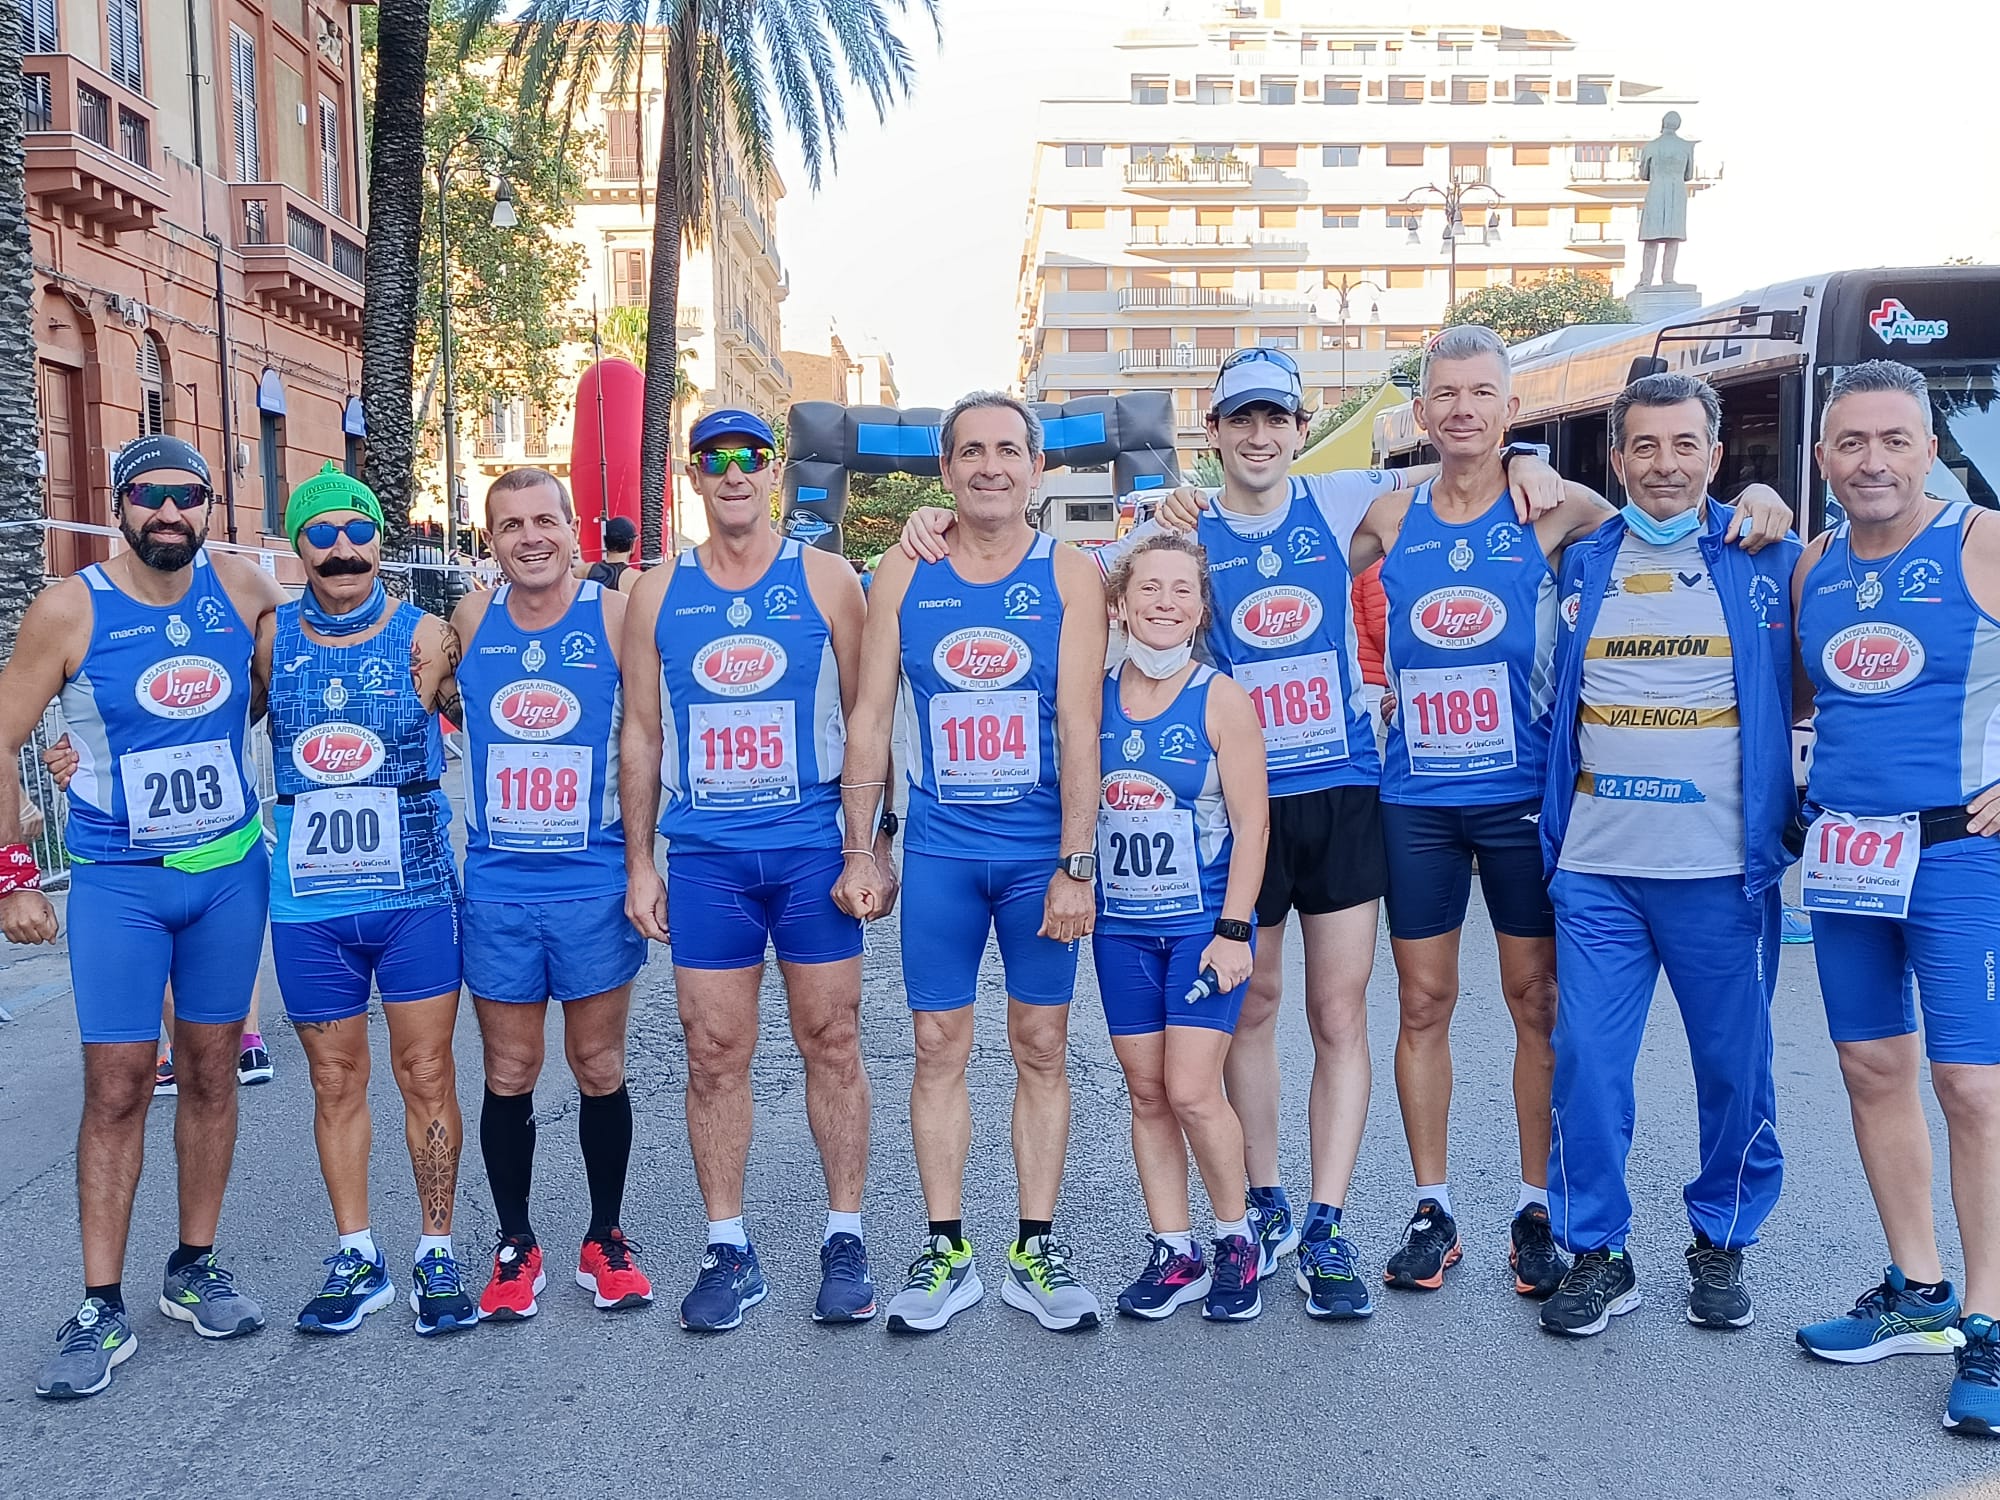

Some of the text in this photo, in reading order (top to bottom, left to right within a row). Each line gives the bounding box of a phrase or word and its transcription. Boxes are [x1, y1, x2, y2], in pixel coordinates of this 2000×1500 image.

[1892, 323, 1946, 336] ANPAS
[1208, 556, 1249, 573] macron
[1817, 580, 1853, 596] macron
[675, 604, 716, 616] macron
[918, 598, 962, 609] macron
[1251, 599, 1306, 634] Sigel
[1427, 598, 1489, 635] Sigel
[109, 625, 156, 640] macron
[1269, 634, 1299, 646] SICILIA
[480, 645, 517, 655] macron
[1445, 637, 1477, 647] SICILIA
[1605, 634, 1710, 658] MARATÓN
[710, 646, 769, 682] Sigel
[951, 639, 1014, 676] Sigel
[1840, 636, 1905, 678] Sigel
[155, 669, 215, 705] Sigel
[729, 684, 760, 695] SICILIA
[969, 679, 1000, 688] SICILIA
[1858, 680, 1891, 691] SICILIA
[177, 705, 207, 717] SICILIA
[505, 689, 563, 726] Sigel
[1248, 676, 1331, 729] 1183
[1412, 687, 1499, 735] 1189
[1609, 708, 1698, 727] VALENCIA
[336, 725, 380, 753] ARTIGIANALE
[522, 729, 551, 738] SICILIA
[941, 714, 1027, 762] 1184
[1309, 727, 1337, 738] UniCredit
[305, 733, 367, 770] Sigel
[700, 725, 783, 771] 1185
[1473, 738, 1505, 748] UniCredit
[324, 772, 355, 782] SICILIA
[999, 768, 1030, 777] UniCredit
[143, 764, 223, 819] 203
[496, 767, 578, 812] 1188
[1109, 781, 1160, 810] Sigel
[1598, 779, 1682, 799] 42.195m
[204, 815, 235, 826] UniCredit
[549, 819, 579, 827] UniCredit
[306, 808, 380, 856] 200
[1110, 831, 1178, 878] 202
[1820, 822, 1904, 869] 1181
[360, 859, 391, 867] UniCredit
[1159, 882, 1190, 892] UniCredit
[1865, 876, 1900, 887] UniCredit
[1984, 951, 1996, 1001] macron
